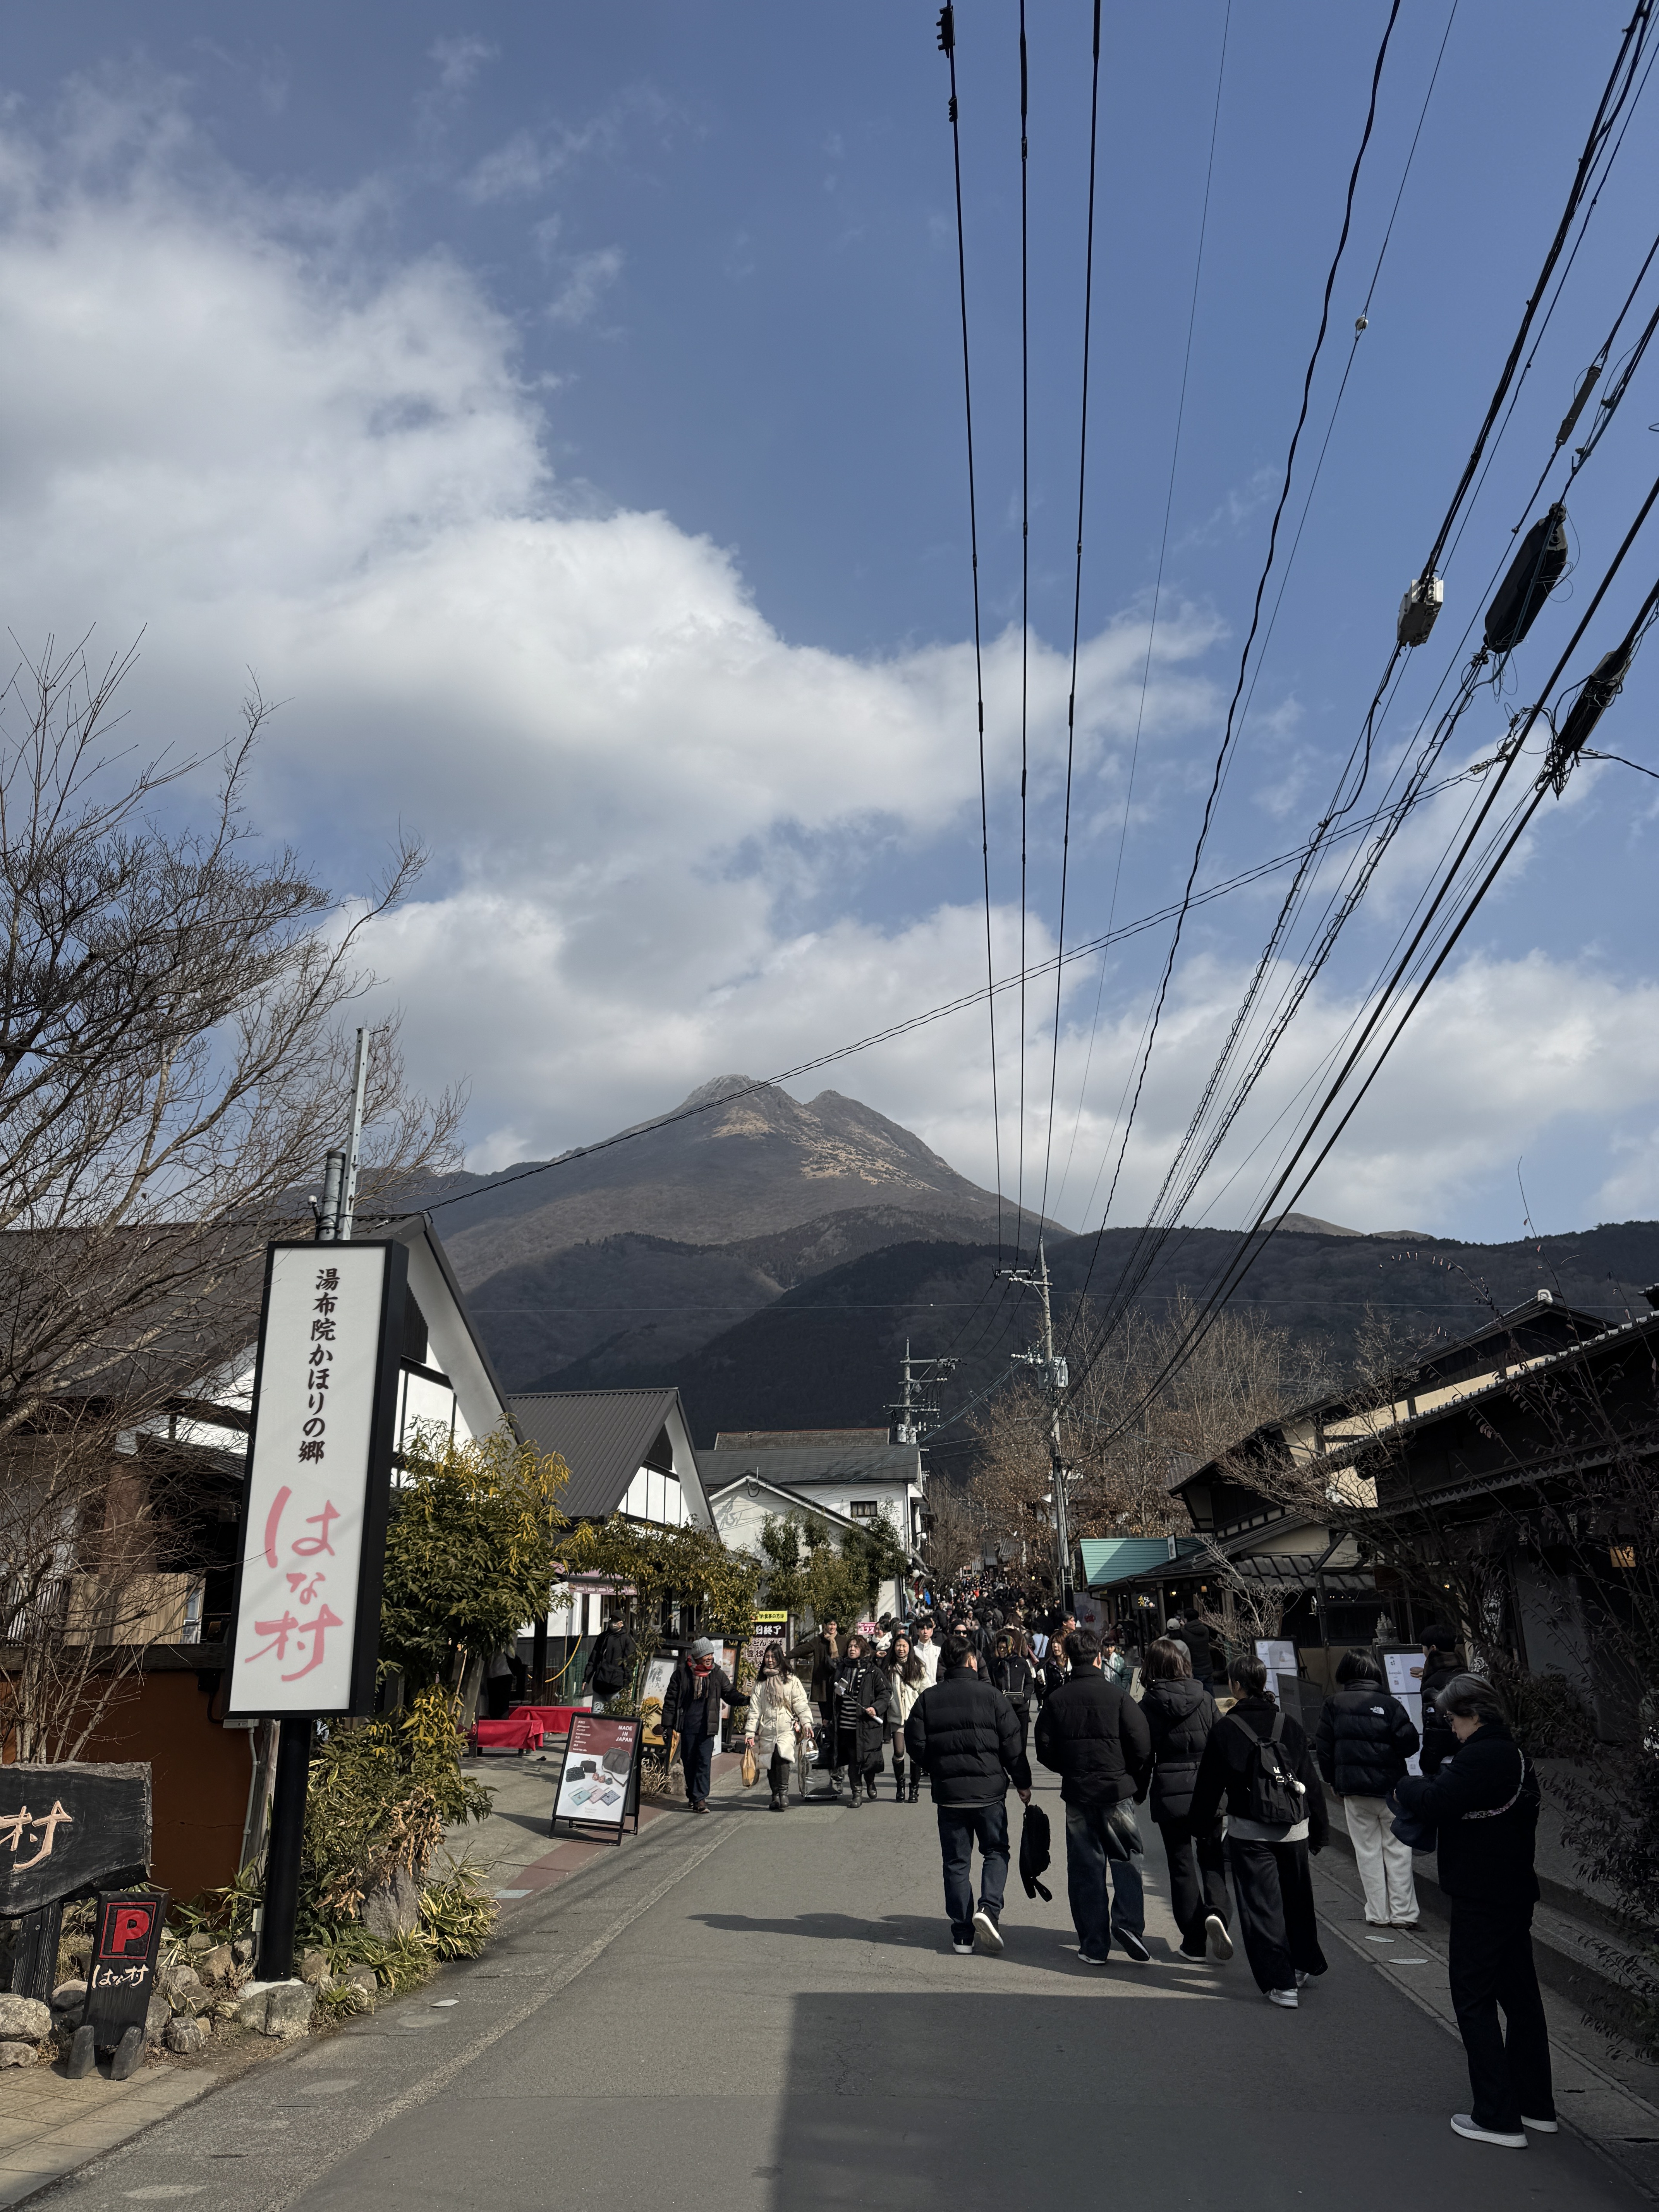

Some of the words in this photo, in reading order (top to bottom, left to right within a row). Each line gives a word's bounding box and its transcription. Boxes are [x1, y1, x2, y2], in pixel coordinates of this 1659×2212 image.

[298, 1267, 341, 1465] 湯布院かほりの郷
[245, 1486, 343, 1682] はな村
[0, 1800, 72, 1872] 村
[112, 1909, 149, 1953] P
[91, 1964, 149, 1989] はな村
